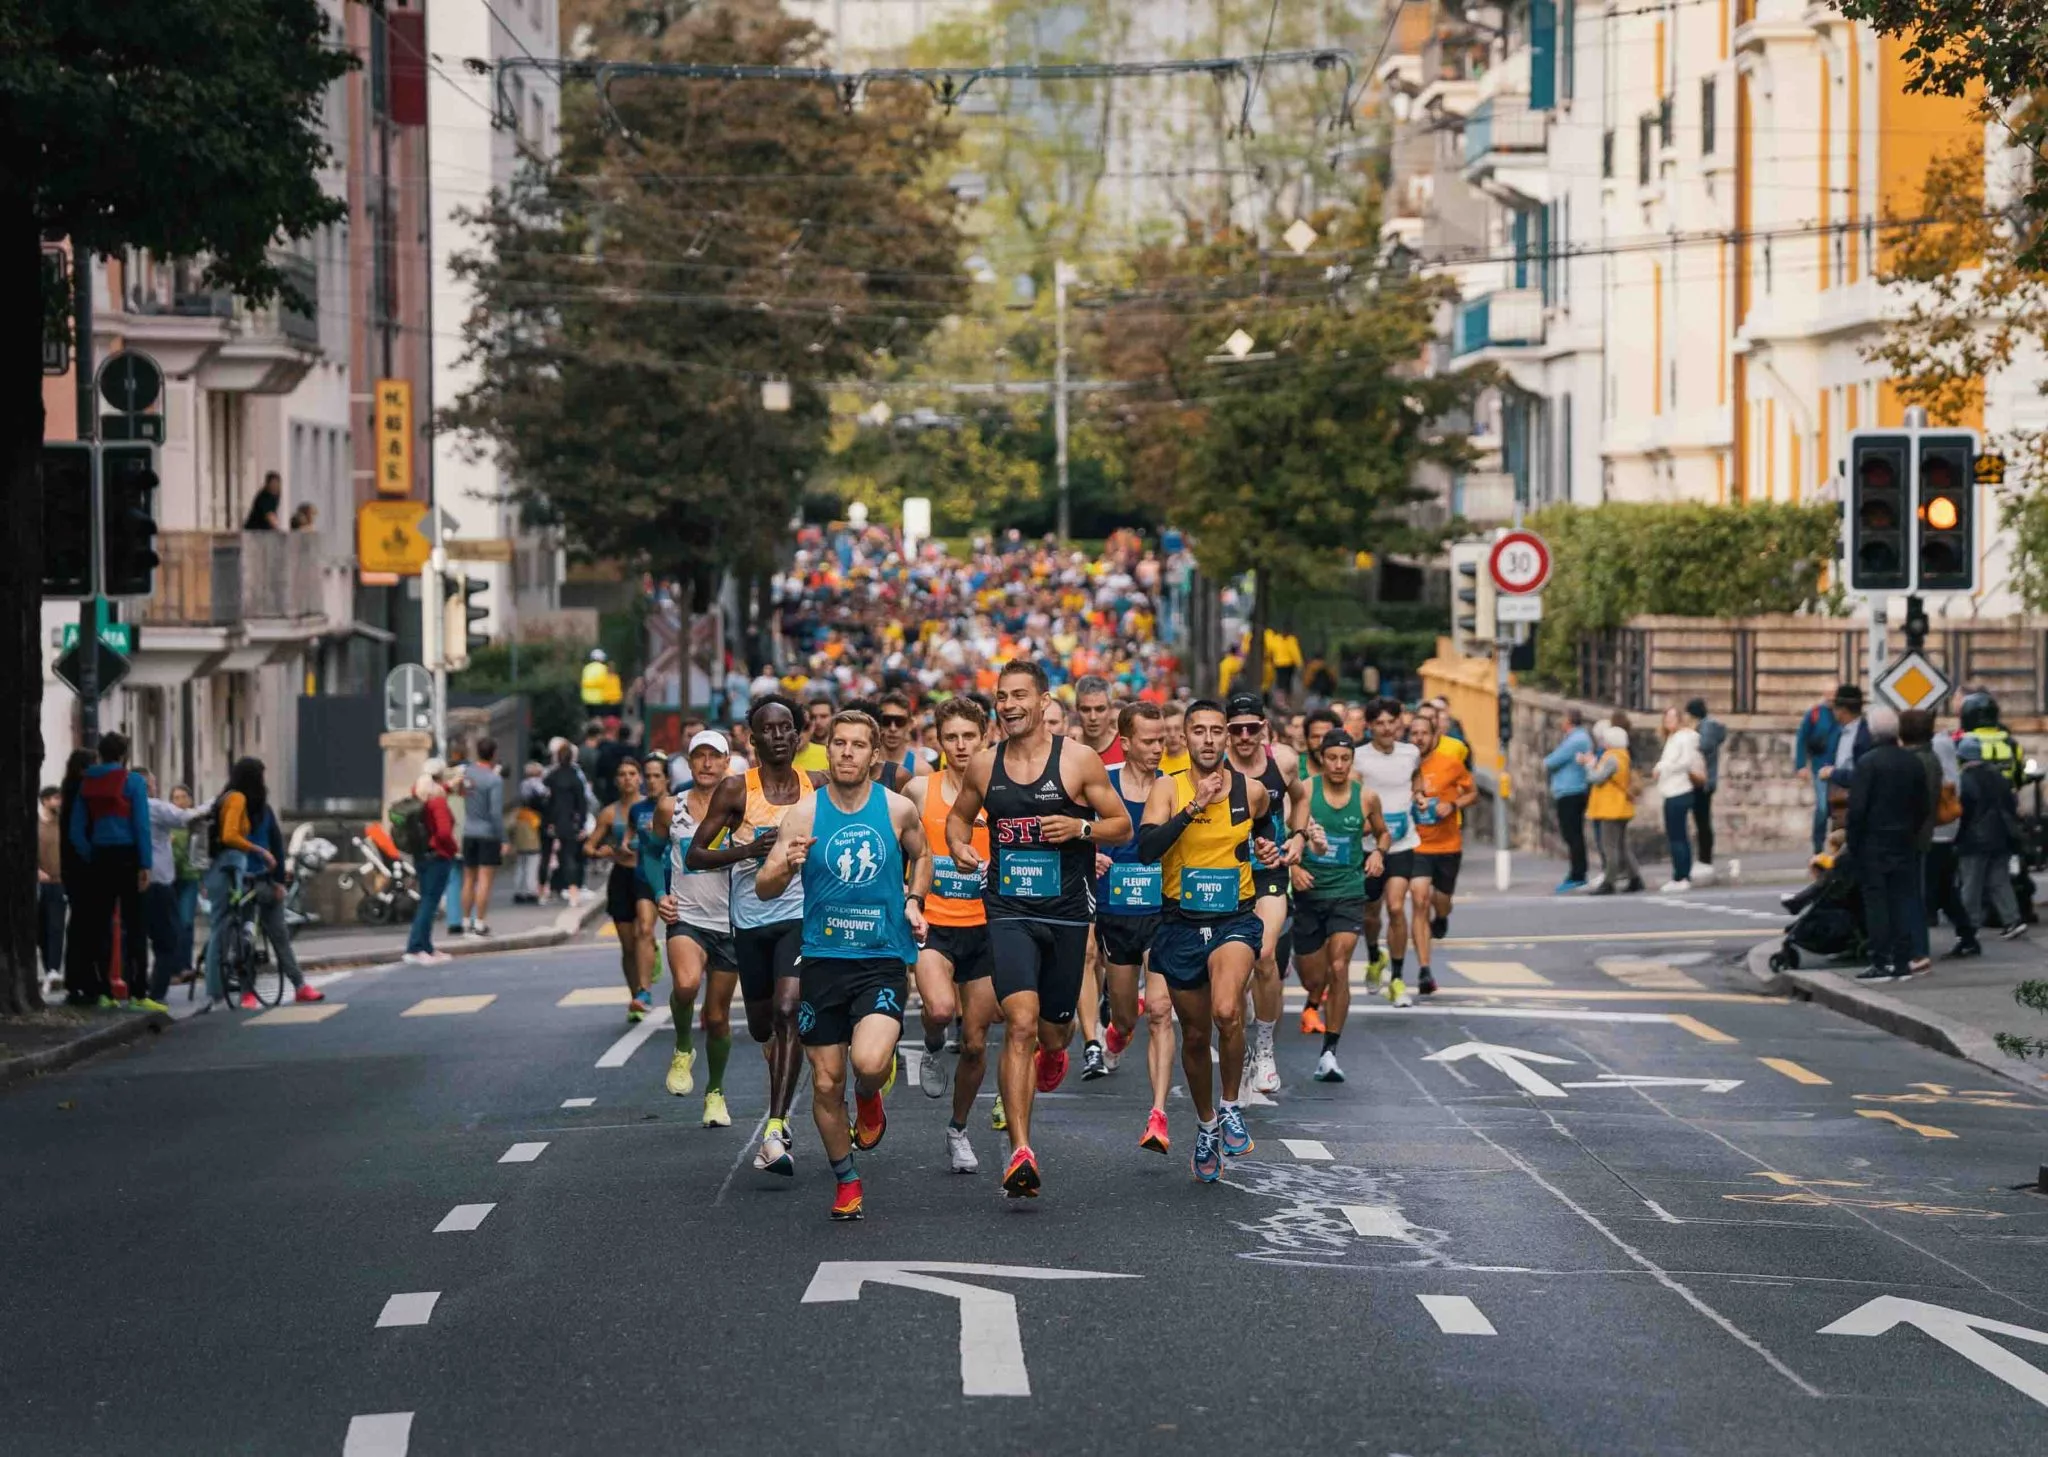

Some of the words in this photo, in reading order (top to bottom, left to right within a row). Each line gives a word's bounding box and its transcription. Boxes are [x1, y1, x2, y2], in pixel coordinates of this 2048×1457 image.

[1507, 552, 1531, 573] 30
[842, 829, 871, 838] Trilogie
[997, 815, 1050, 844] ST
[834, 837, 856, 846] Sport
[1010, 866, 1043, 877] BROWN
[952, 881, 963, 890] 32
[1021, 876, 1032, 887] 38
[1122, 877, 1152, 887] FLEURY
[1131, 887, 1142, 896] 42
[1196, 882, 1222, 892] PINTO
[1203, 892, 1214, 902] 37
[827, 916, 875, 932] SCHOUWEY
[844, 930, 855, 940] 33
